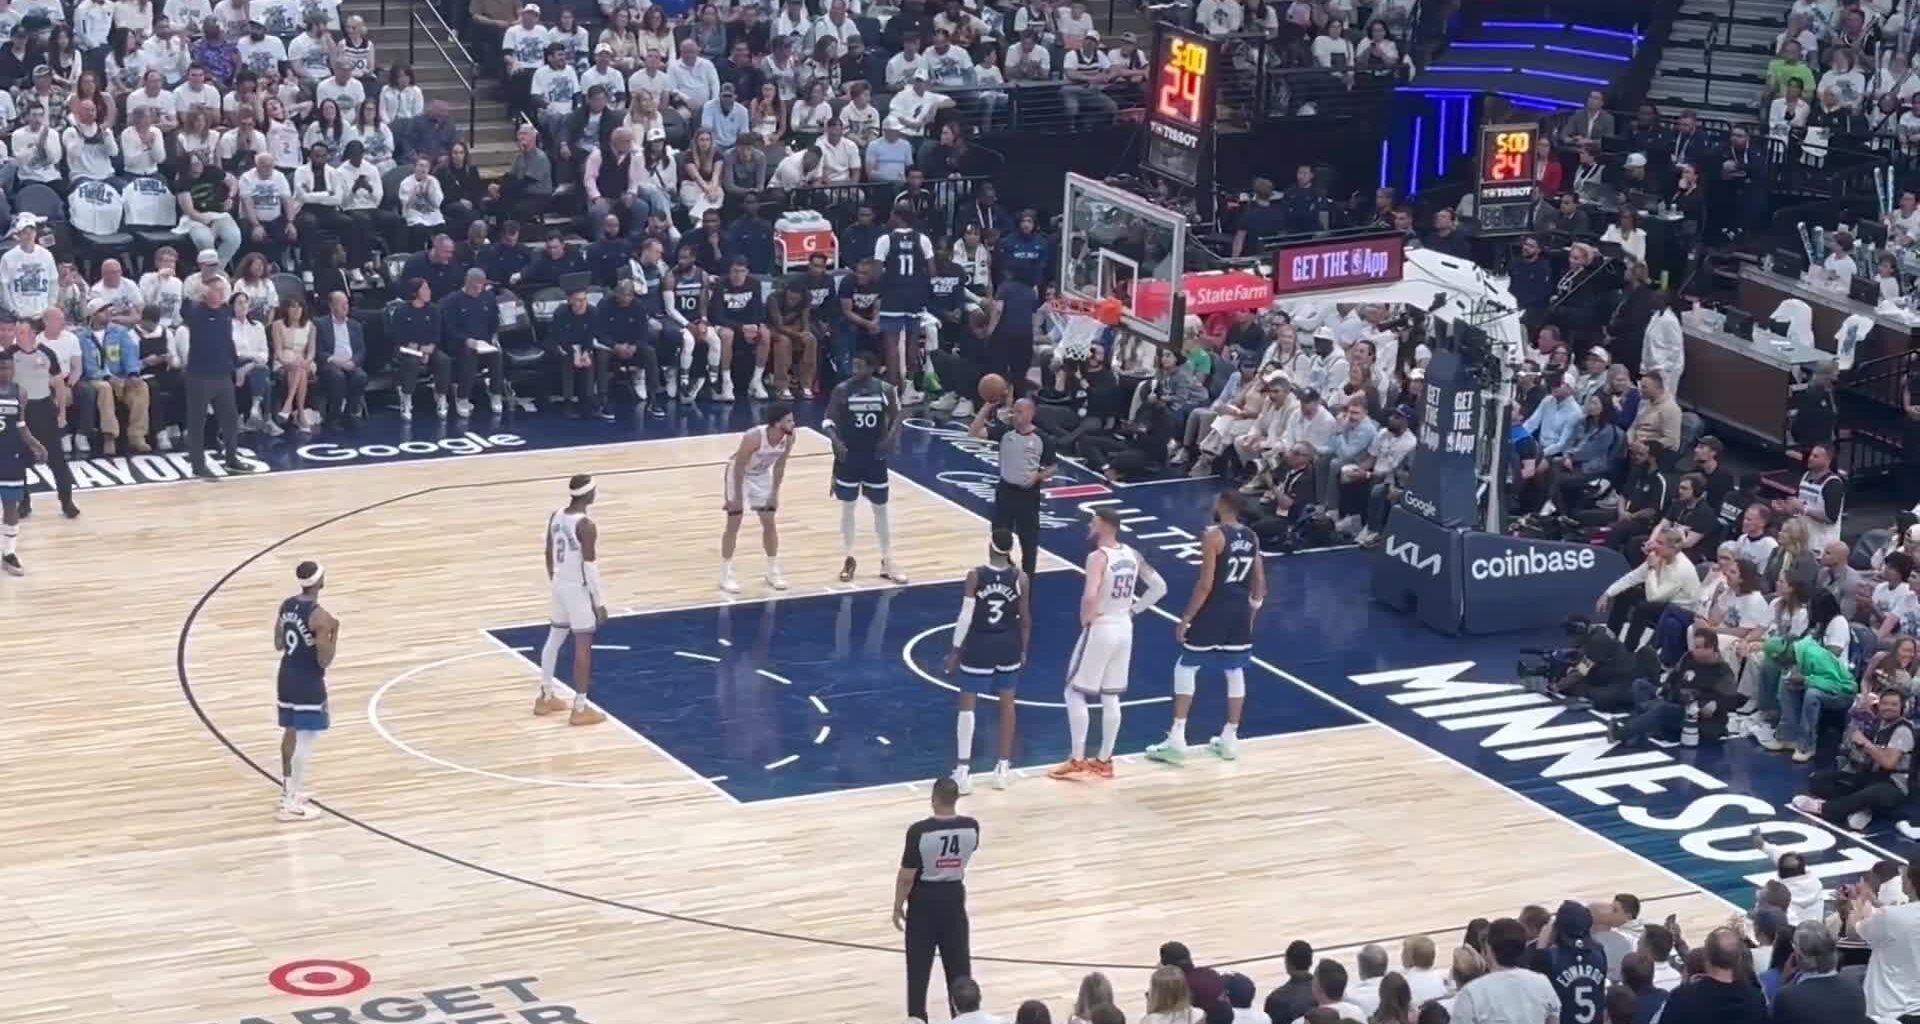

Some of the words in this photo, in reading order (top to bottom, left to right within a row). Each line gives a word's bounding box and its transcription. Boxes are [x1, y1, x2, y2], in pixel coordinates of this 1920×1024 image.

[1170, 38, 1208, 75] 5:00
[1159, 64, 1201, 122] 24
[1164, 125, 1199, 149] TISSOT
[1491, 153, 1523, 180] 24
[802, 234, 818, 251] G
[899, 253, 914, 276] 11
[1292, 254, 1319, 282] GET
[1321, 250, 1349, 279] THE
[1363, 248, 1389, 277] App
[680, 295, 697, 310] 10
[1454, 391, 1475, 410] GET
[854, 412, 877, 428] 30
[1453, 410, 1473, 431] THE
[296, 431, 527, 461] Google
[1404, 490, 1437, 517] Google
[556, 538, 566, 563] 2
[1386, 535, 1442, 576] KIA
[1471, 546, 1595, 580] coinbase
[1224, 556, 1255, 584] 27
[1110, 574, 1135, 599] 55
[986, 599, 1006, 625] 3
[285, 629, 298, 656] 9
[939, 834, 961, 857] 74
[1574, 985, 1597, 1024] 5
